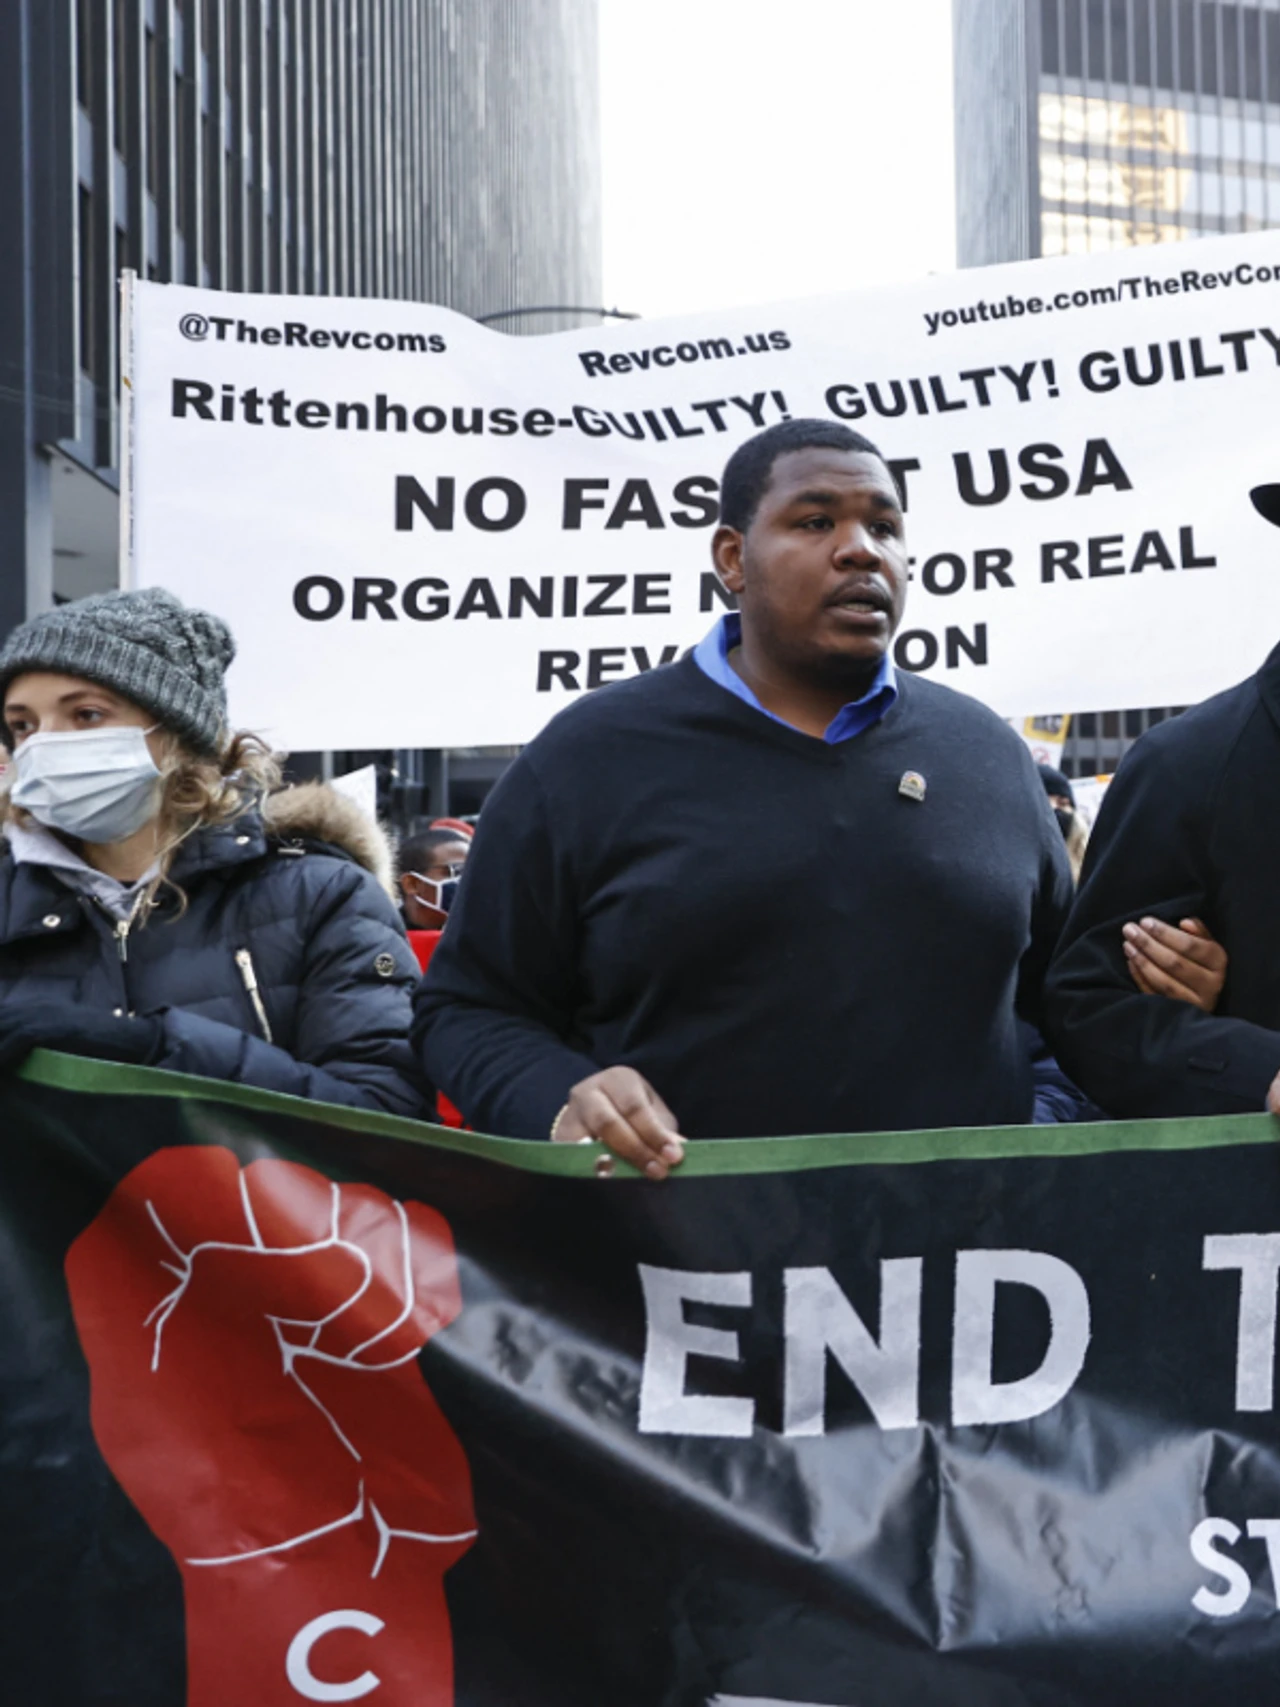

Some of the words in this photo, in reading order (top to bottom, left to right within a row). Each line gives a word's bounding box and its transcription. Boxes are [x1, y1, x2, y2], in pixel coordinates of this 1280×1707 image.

[179, 313, 446, 353] @TheRevcoms
[578, 331, 791, 377] Revcom.us
[172, 378, 792, 441] Rittenhouse-GUILTY!
[825, 359, 1060, 420] GUILTY!
[395, 475, 526, 532] NO
[562, 455, 921, 530] FAST
[952, 438, 1133, 506] USA
[293, 573, 671, 622] ORGANIZE
[1041, 526, 1217, 583] REAL
[638, 1249, 1091, 1443] END
[286, 1609, 385, 1702] C
